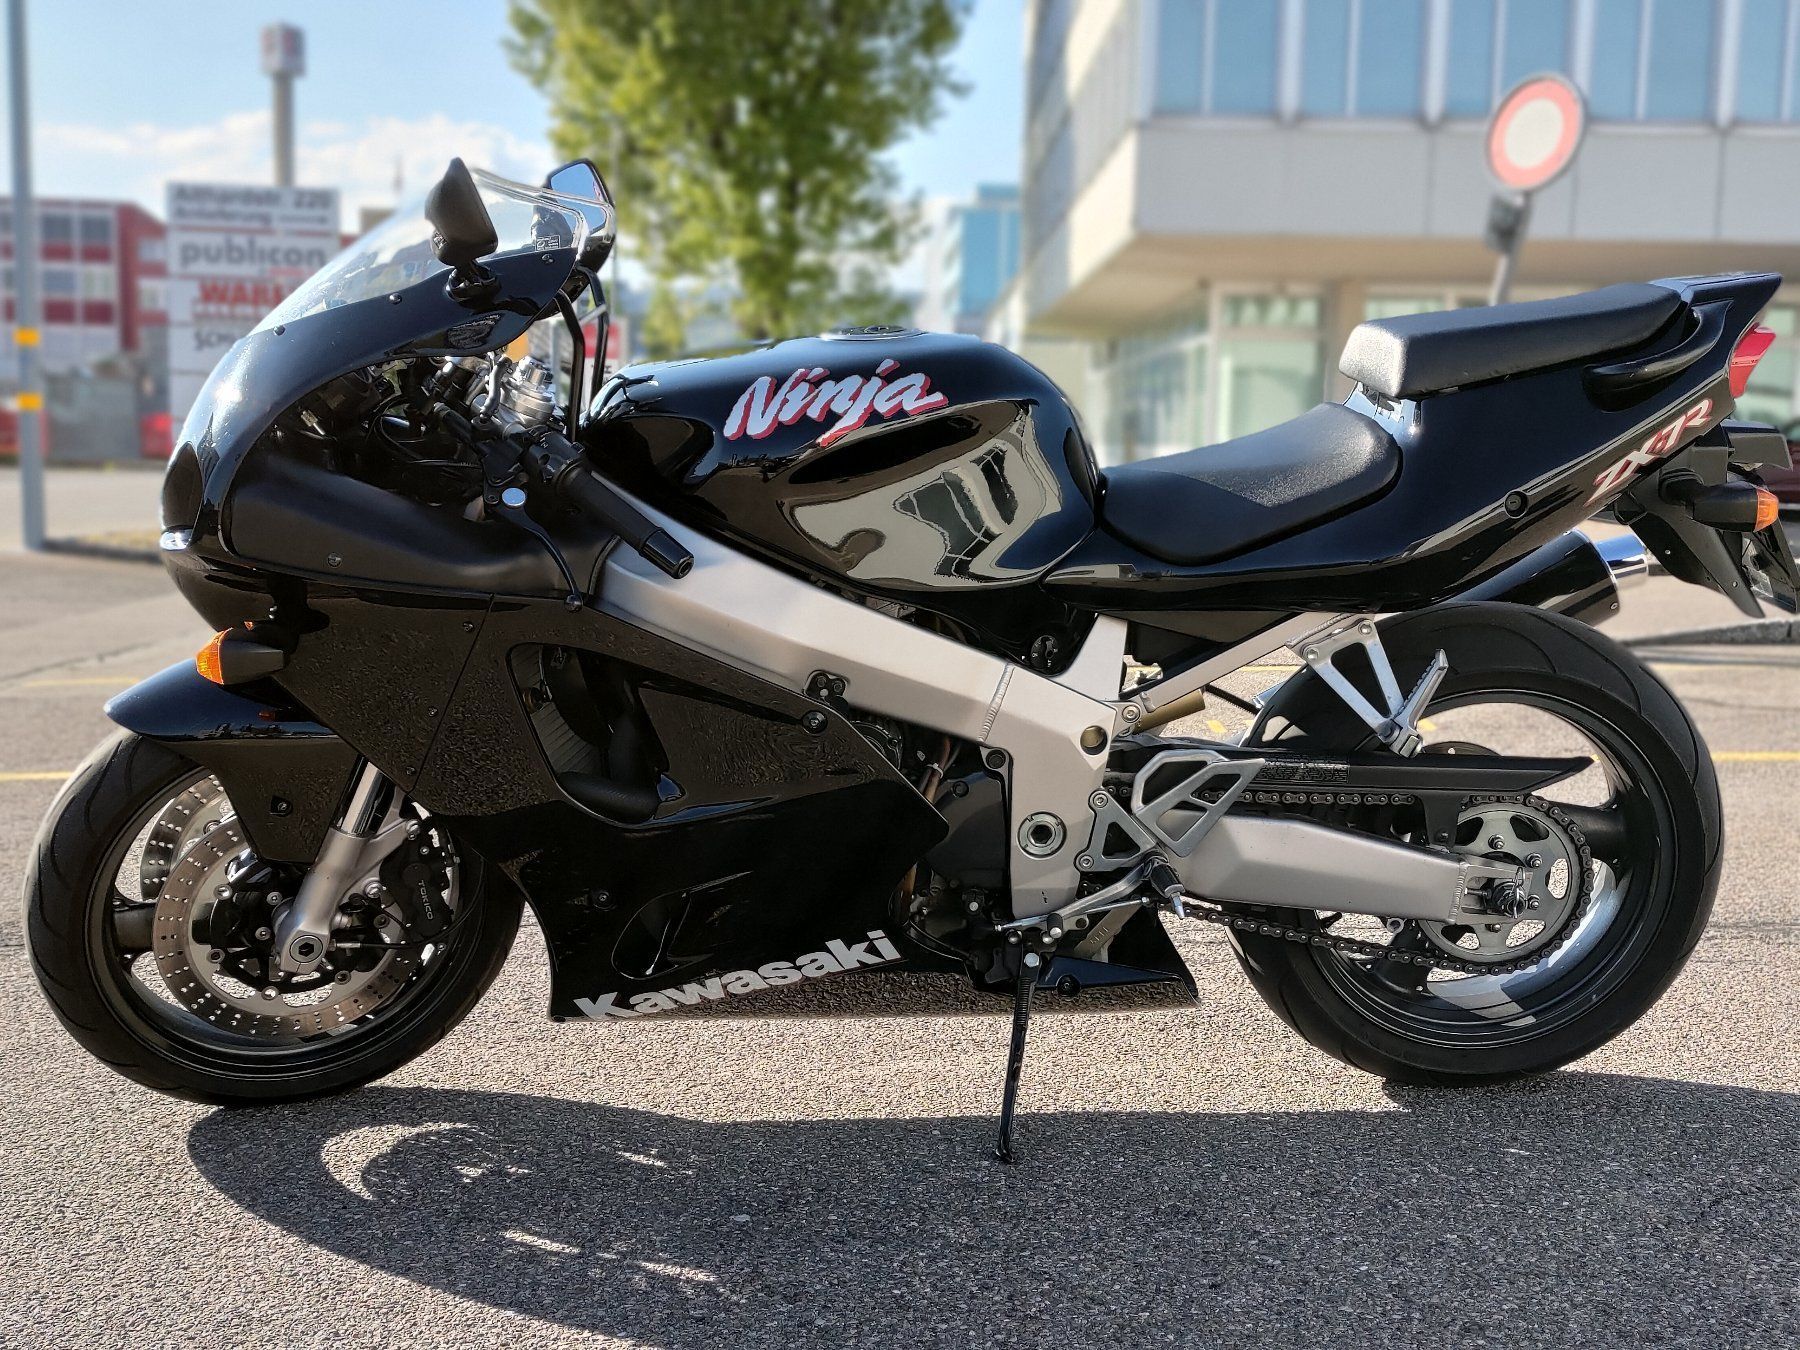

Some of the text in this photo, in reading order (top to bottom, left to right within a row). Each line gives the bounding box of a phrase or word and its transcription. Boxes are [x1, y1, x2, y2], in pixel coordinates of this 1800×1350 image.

[180, 235, 327, 268] publicon
[723, 358, 949, 447] Ninja
[418, 880, 434, 920] TOKICO
[573, 929, 902, 1020] Kawasaki
